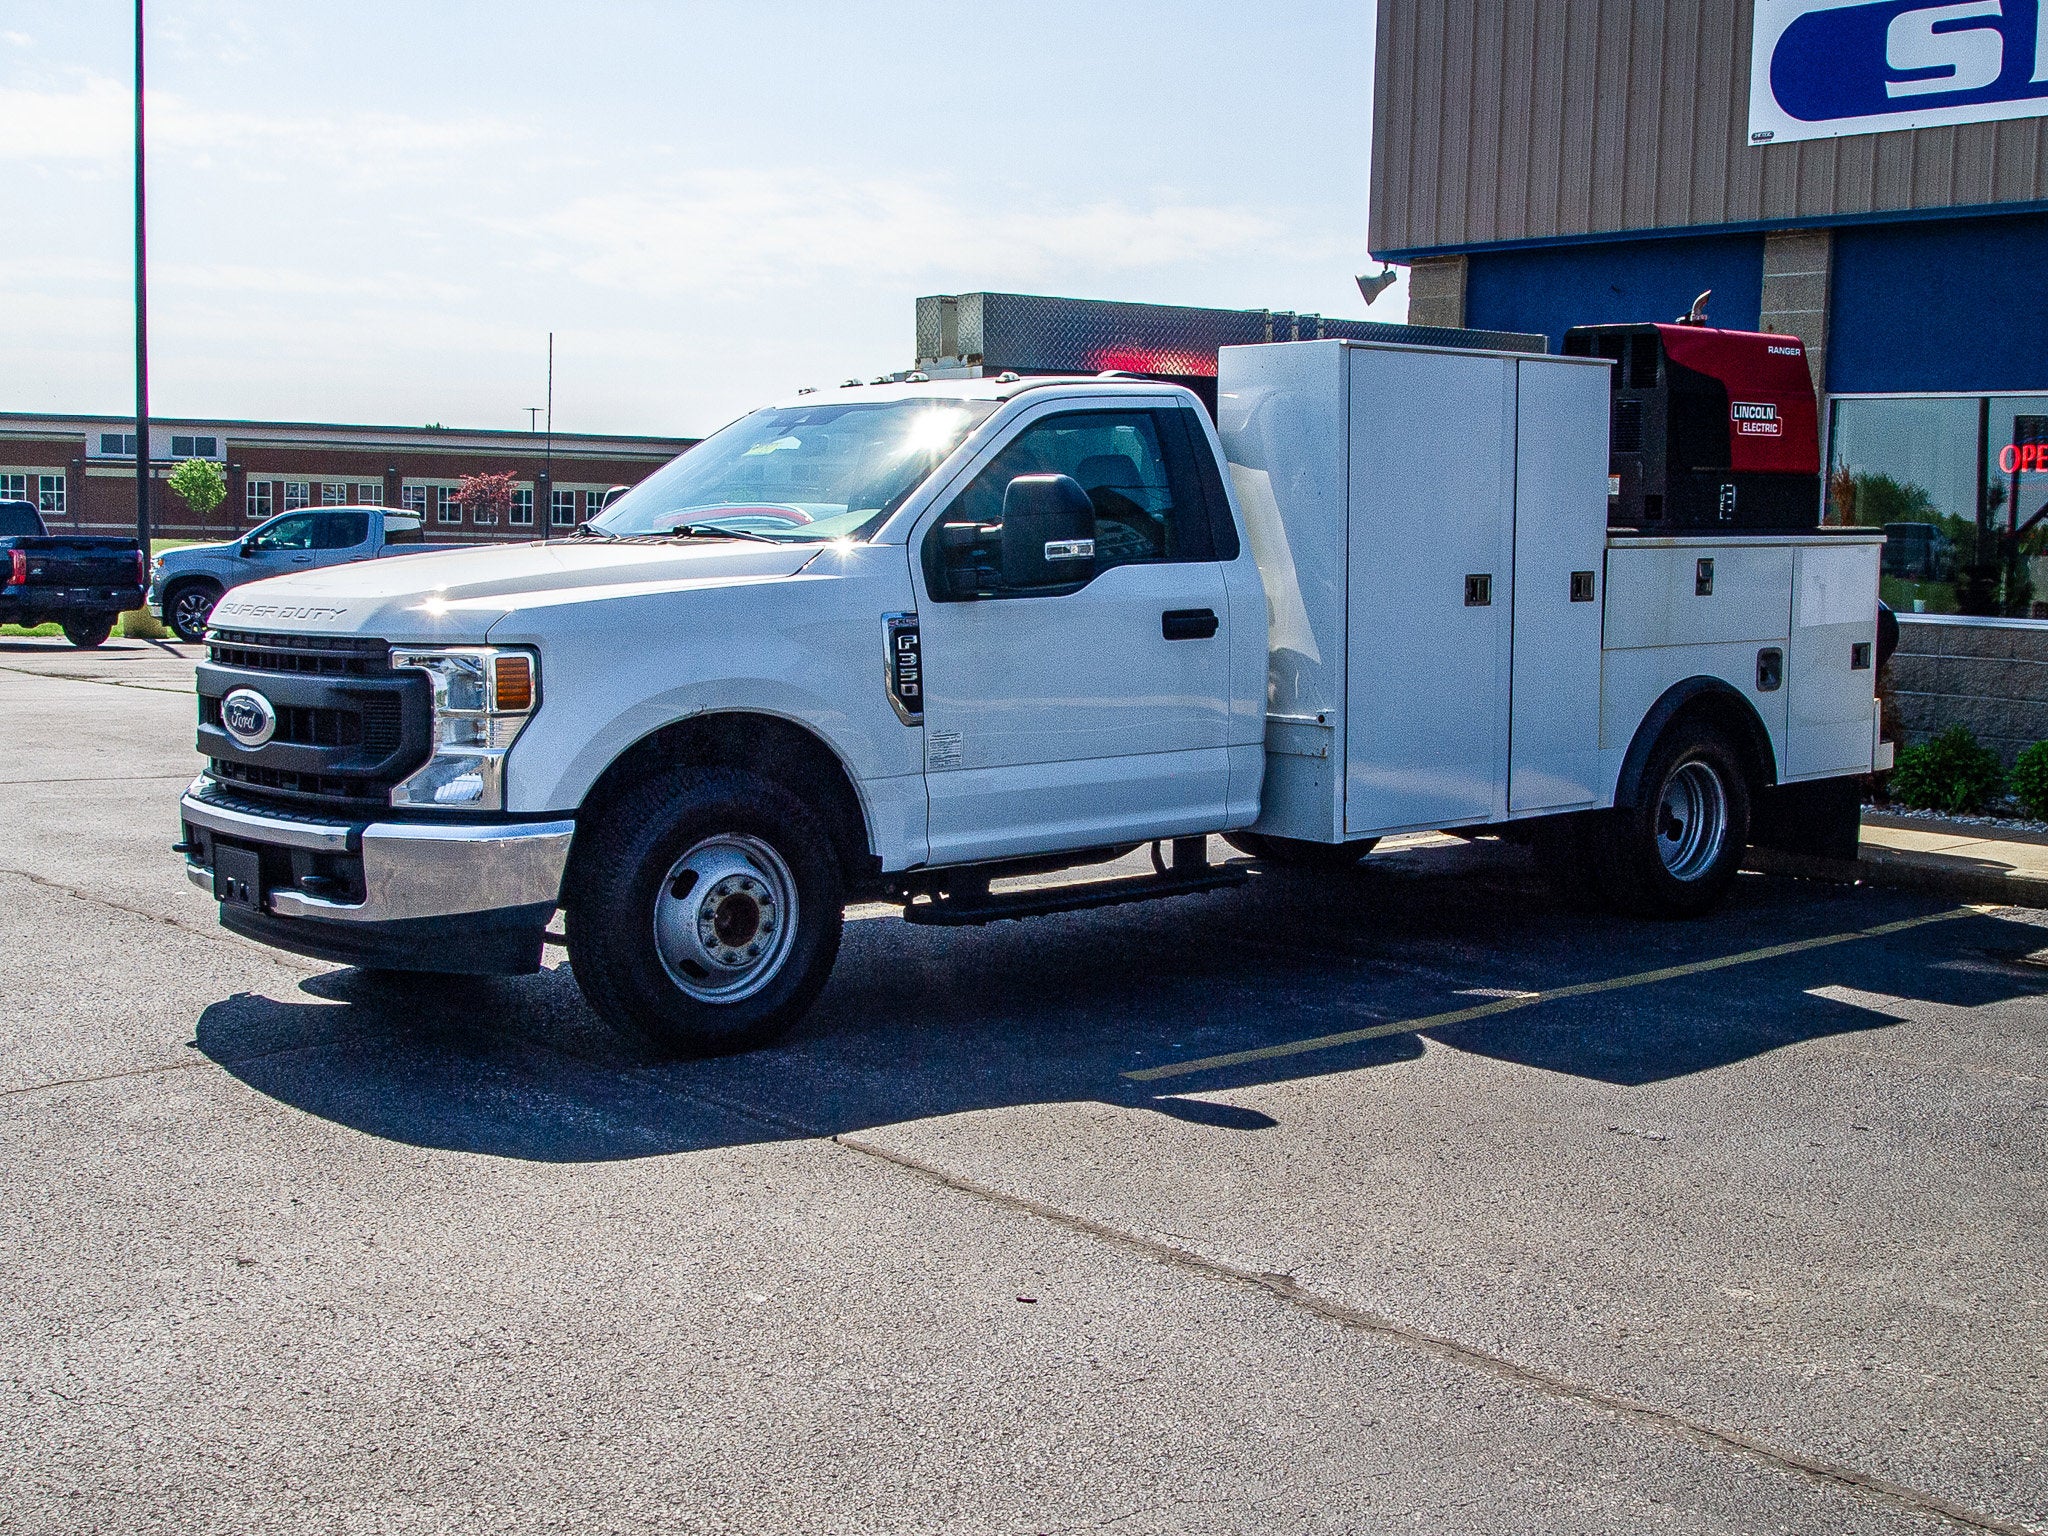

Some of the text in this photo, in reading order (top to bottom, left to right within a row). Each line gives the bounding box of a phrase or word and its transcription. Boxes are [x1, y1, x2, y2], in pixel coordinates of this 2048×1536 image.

[1768, 346, 1800, 356] RANGER
[1734, 405, 1774, 420] LINCOLN
[1742, 422, 1778, 433] ELECTRIC
[220, 603, 348, 622] SUPER DUTY
[897, 634, 919, 696] F350
[231, 703, 256, 729] Ford
